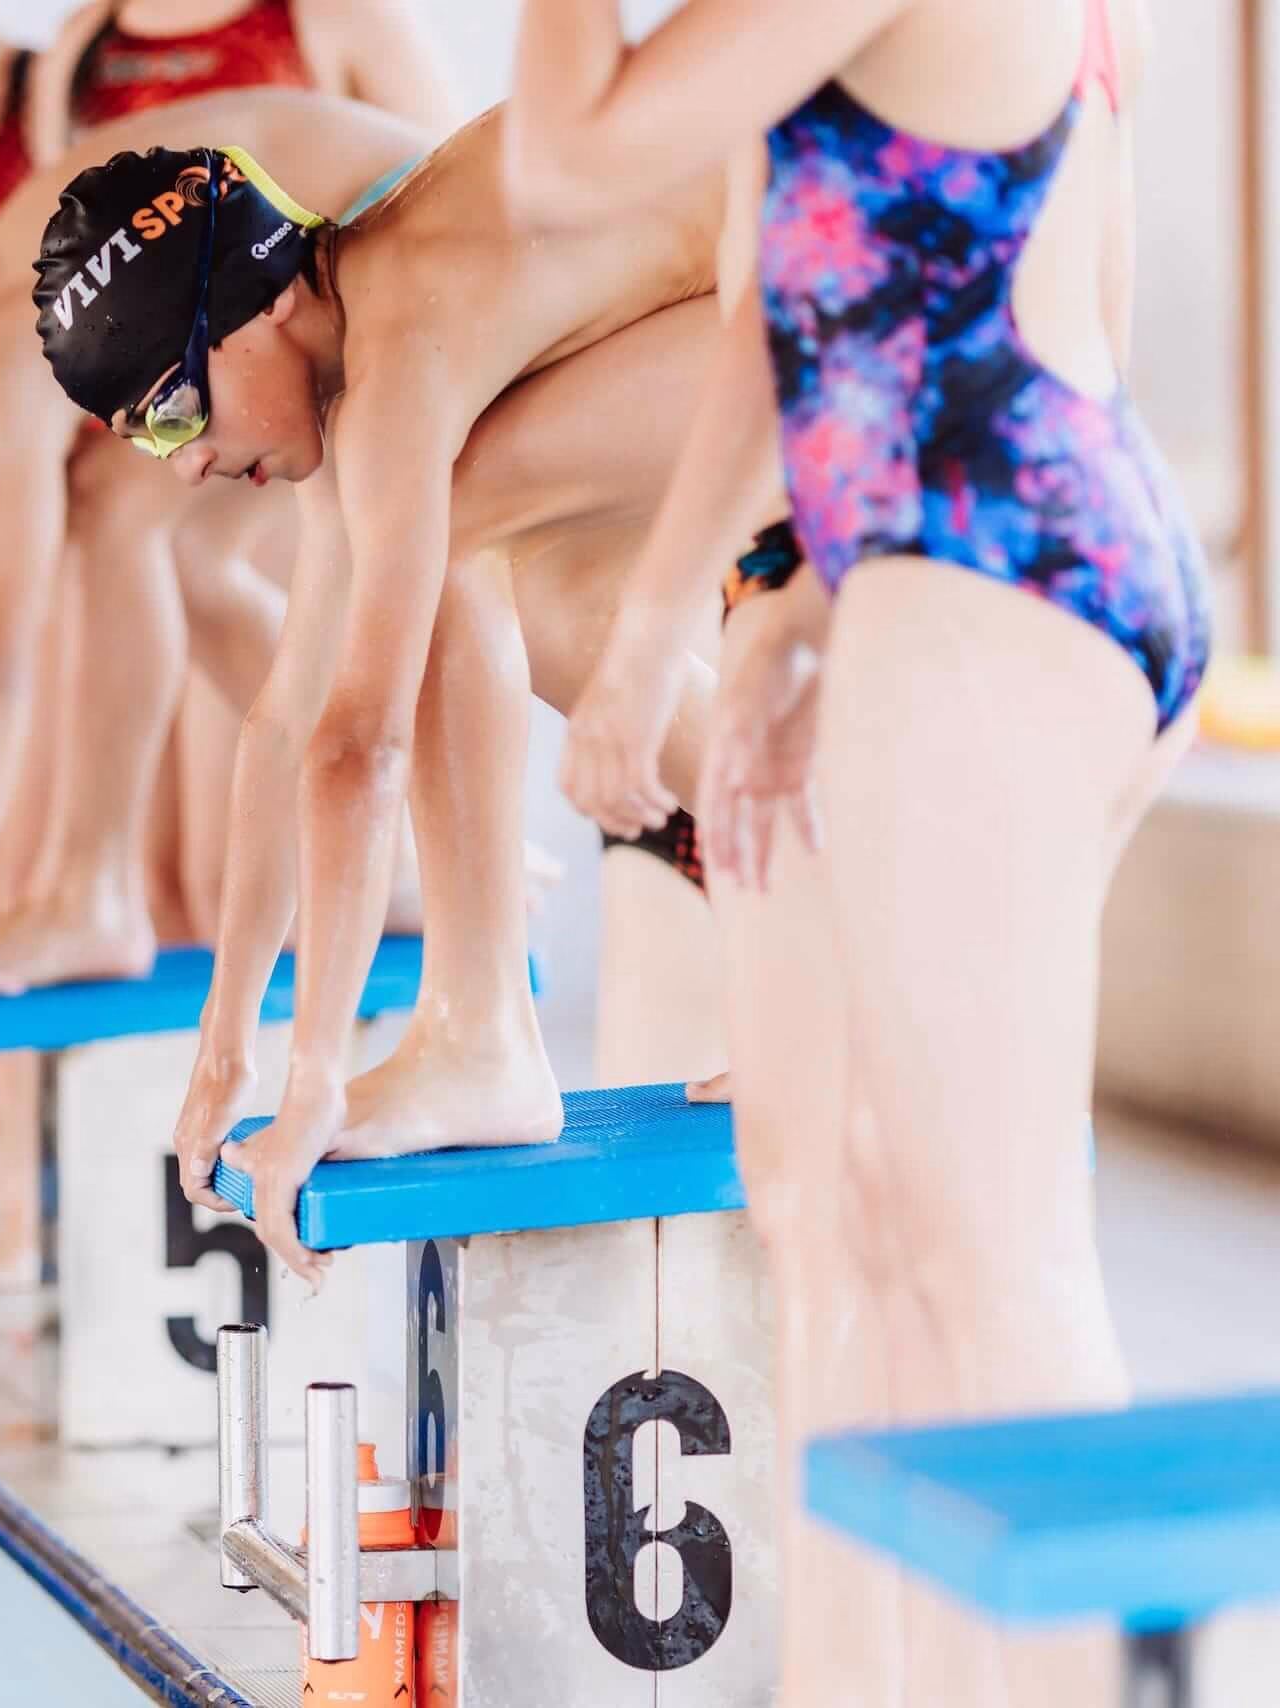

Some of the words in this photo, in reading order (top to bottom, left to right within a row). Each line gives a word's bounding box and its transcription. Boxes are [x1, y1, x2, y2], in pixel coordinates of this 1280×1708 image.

[53, 228, 142, 331] VIVI
[166, 1154, 269, 1373] 5
[584, 1369, 732, 1671] 6
